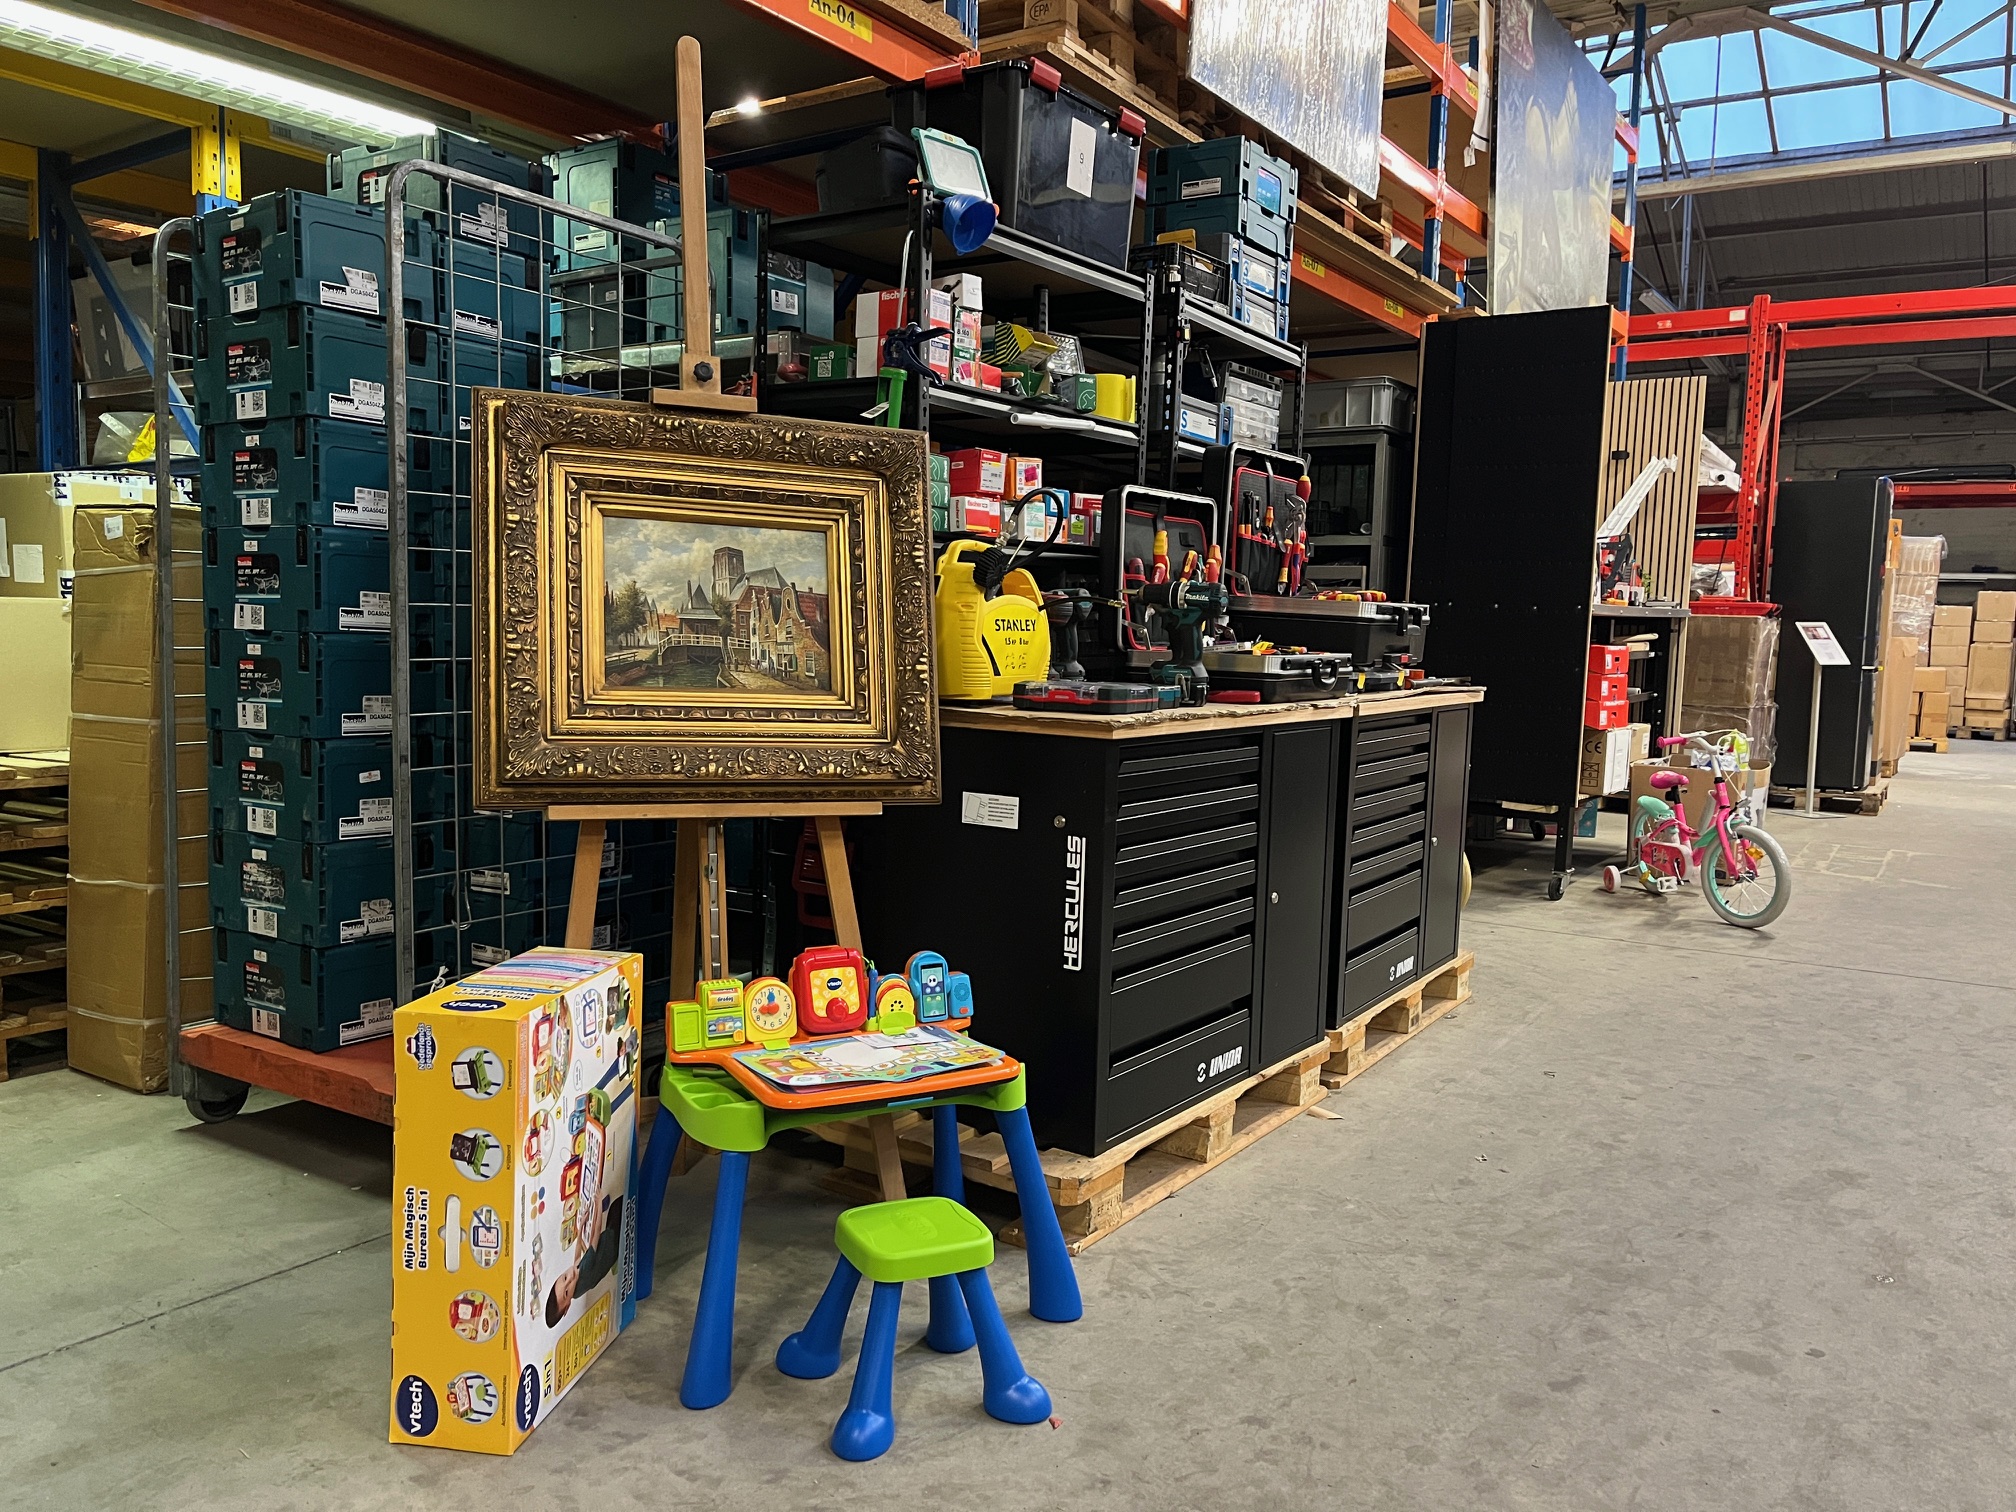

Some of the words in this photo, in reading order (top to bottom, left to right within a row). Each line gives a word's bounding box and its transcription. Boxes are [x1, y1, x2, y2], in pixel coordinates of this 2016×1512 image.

[810, 0, 856, 30] An-04
[1033, 1, 1050, 18] EPA
[1079, 152, 1085, 165] 9
[881, 289, 907, 301] fischr
[1181, 410, 1188, 429] S
[995, 618, 1036, 632] STANLEY
[1063, 835, 1085, 971] HERCULES
[449, 1001, 498, 1009] vtech
[425, 1025, 433, 1070] gesproken
[1209, 1045, 1243, 1077] UNIOR
[404, 1187, 416, 1240] Magisch
[418, 1198, 428, 1211] in
[418, 1213, 427, 1221] 5
[404, 1242, 416, 1270] Mijn
[418, 1230, 427, 1269] Bureau
[545, 1369, 552, 1384] in
[522, 1366, 532, 1429] vtech
[543, 1386, 552, 1398] 5
[409, 1380, 423, 1433] vtech
